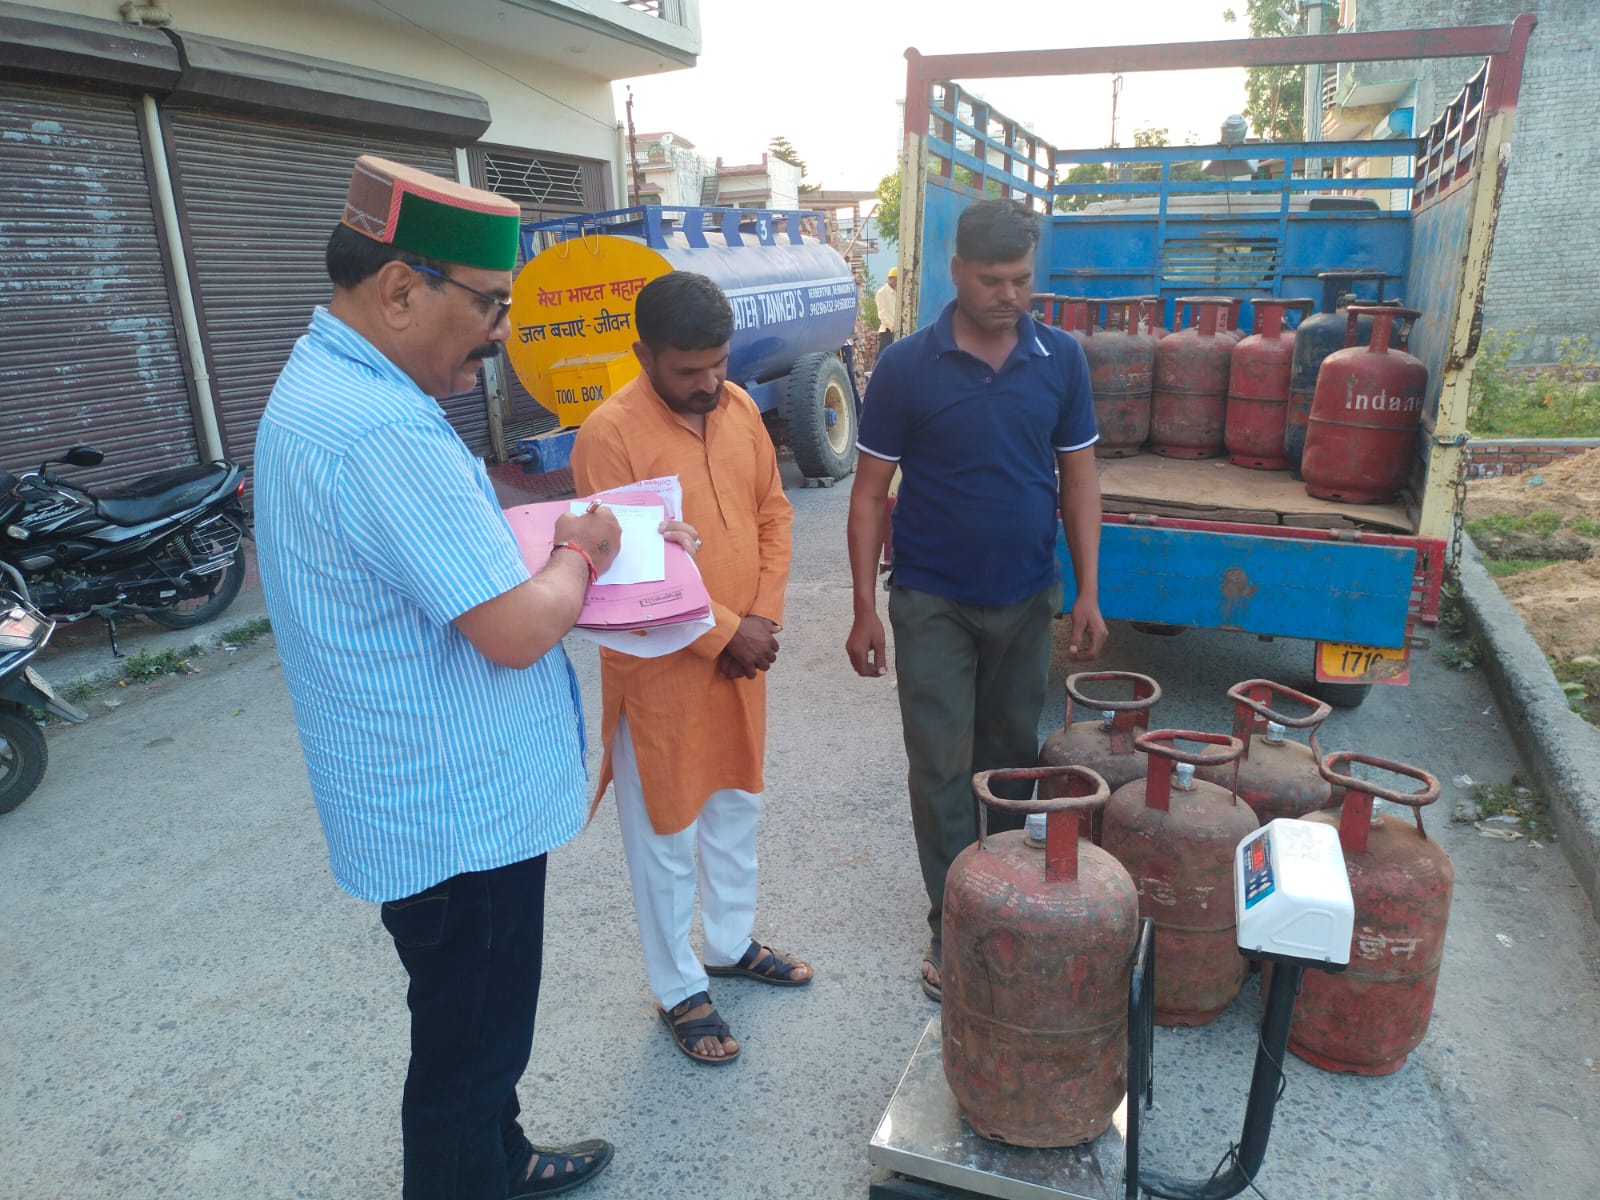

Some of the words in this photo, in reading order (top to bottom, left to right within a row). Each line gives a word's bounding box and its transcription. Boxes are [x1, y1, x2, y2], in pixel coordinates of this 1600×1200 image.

[760, 219, 768, 241] 3
[537, 287, 562, 307] मेरा
[566, 284, 605, 303] भारत
[758, 289, 805, 325] TANKER'S
[518, 324, 546, 343] जल
[556, 388, 579, 404] TOOL
[581, 384, 604, 402] BOX
